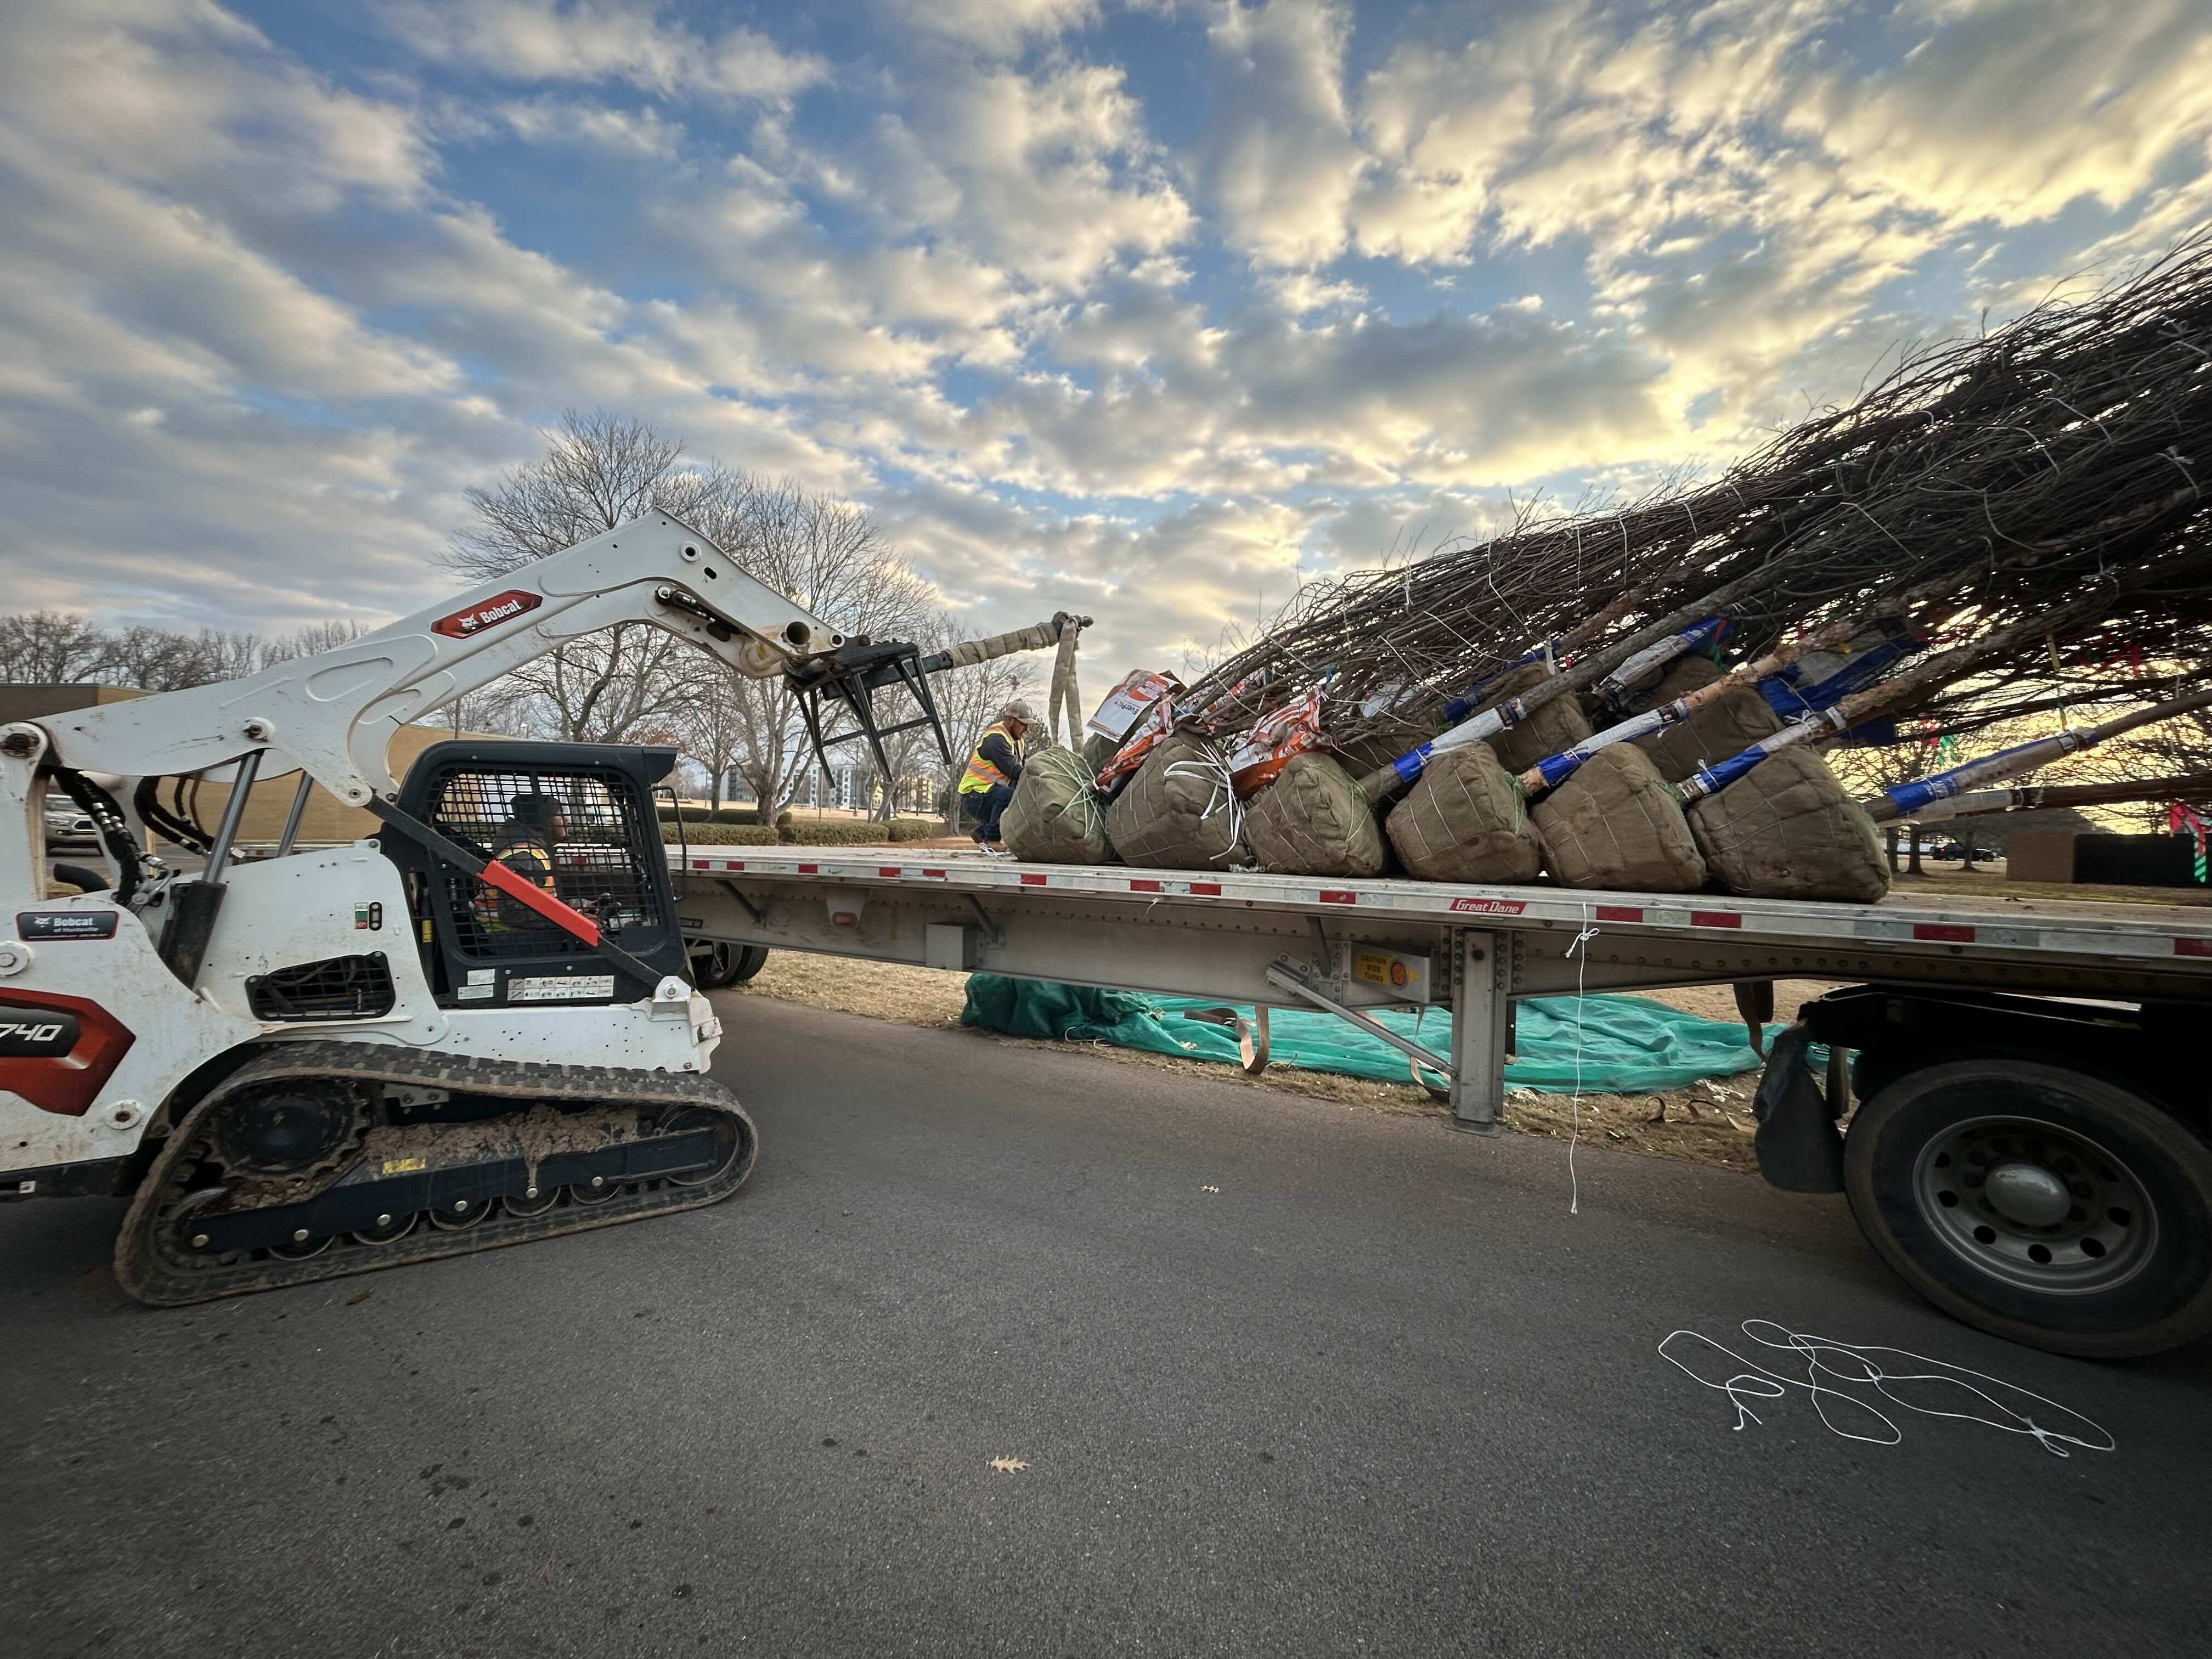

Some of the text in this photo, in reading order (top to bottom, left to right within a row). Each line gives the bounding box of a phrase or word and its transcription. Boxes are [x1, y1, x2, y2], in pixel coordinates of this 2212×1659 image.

[479, 599, 522, 624] Bobcat
[1455, 899, 1519, 914] Great Dane
[53, 917, 94, 927] Bobcat
[1360, 955, 1386, 965] CAUTION
[1364, 972, 1384, 983] TURNS
